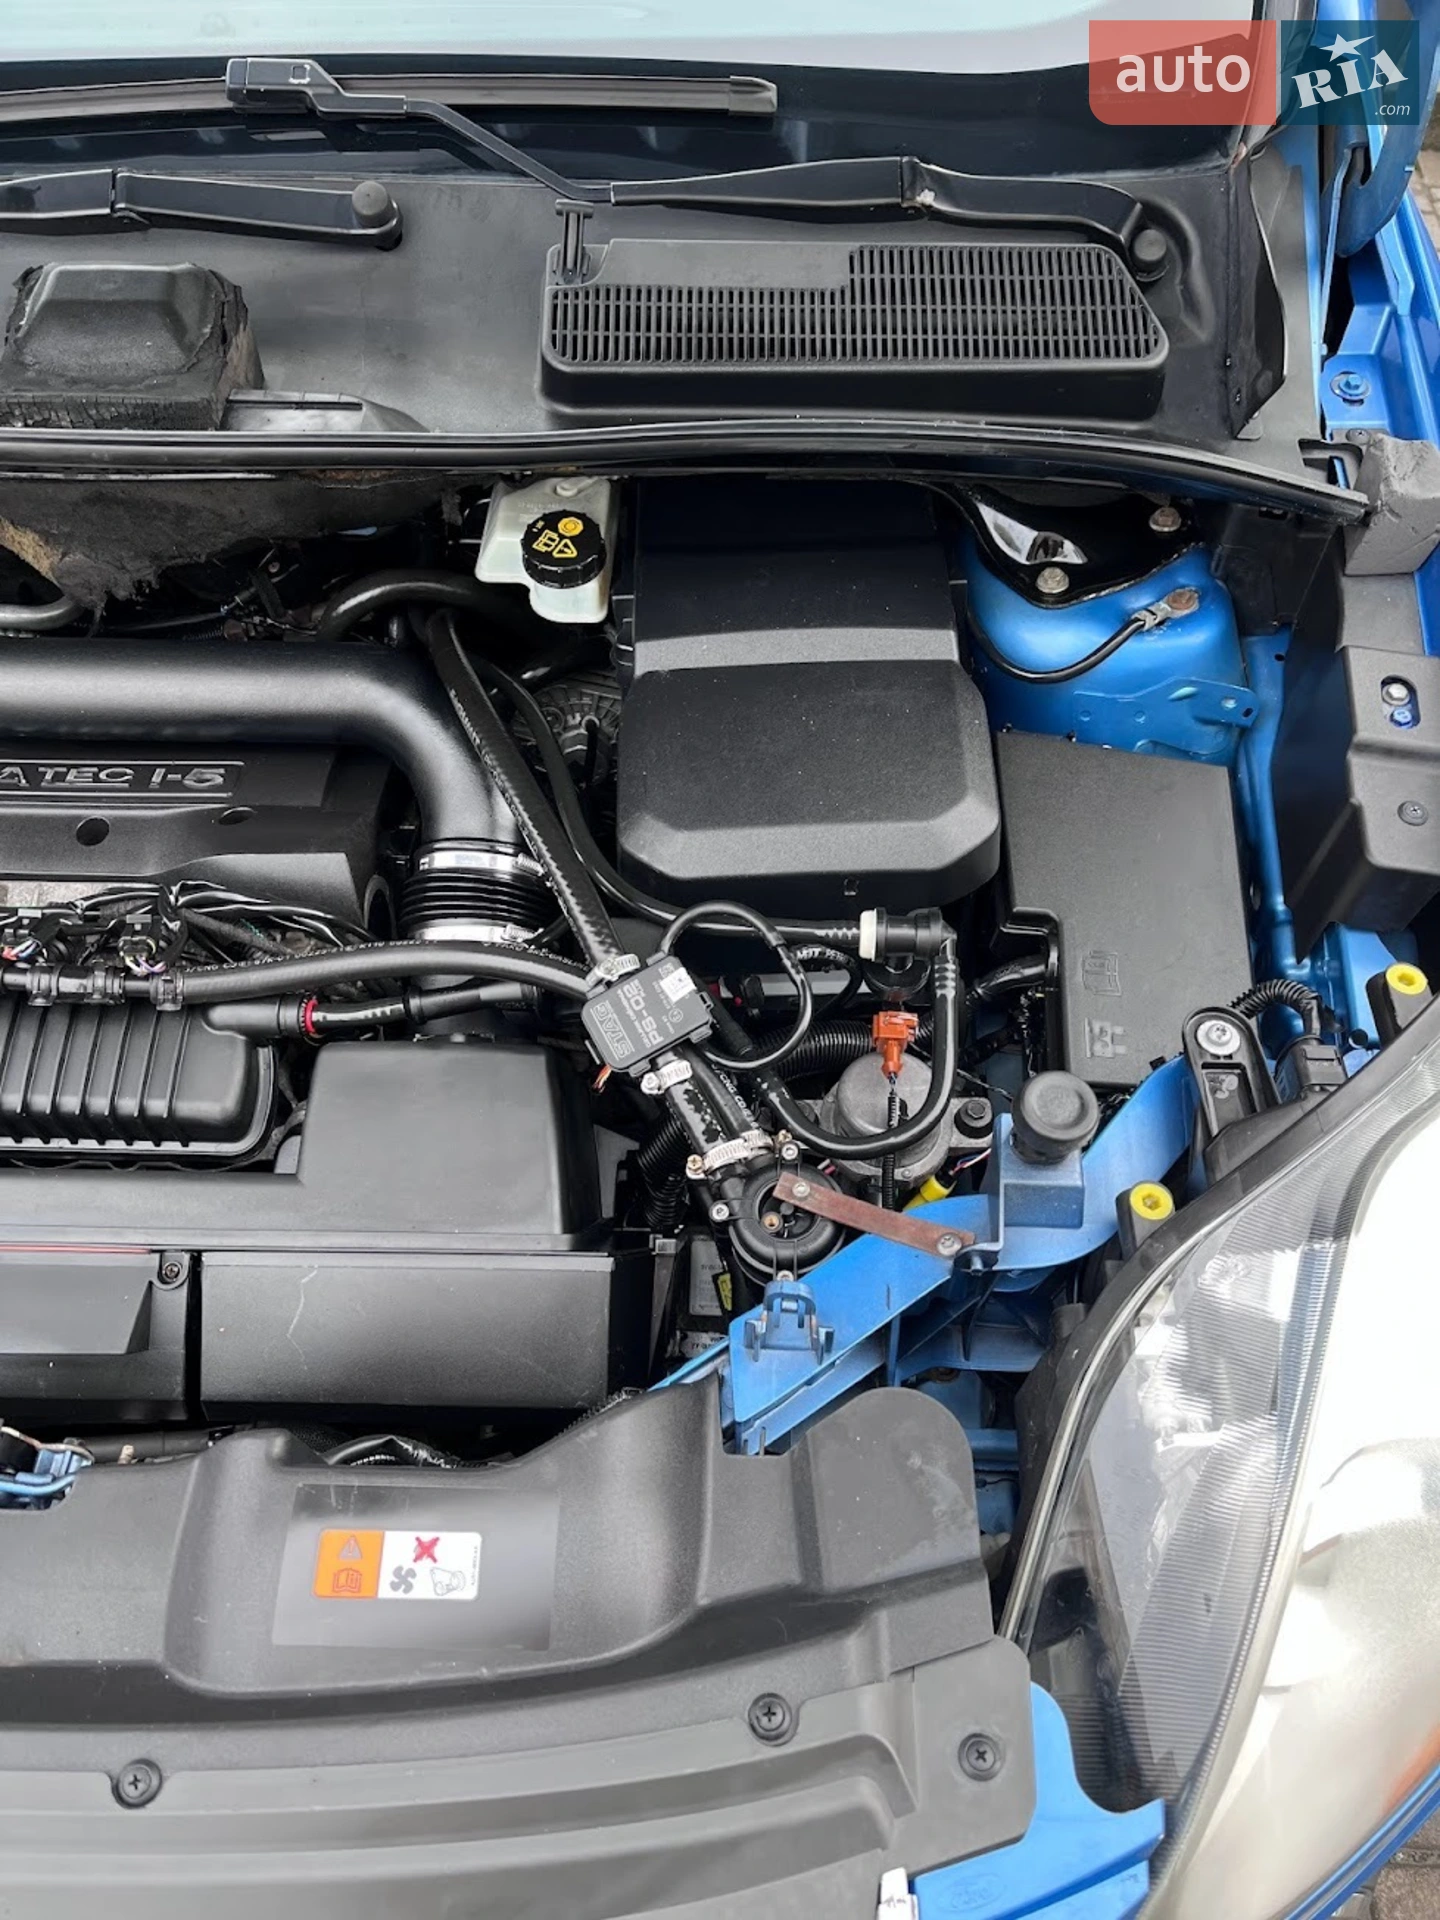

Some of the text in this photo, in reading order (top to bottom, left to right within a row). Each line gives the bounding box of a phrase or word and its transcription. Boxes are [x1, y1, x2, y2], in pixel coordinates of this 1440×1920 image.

[149, 768, 226, 789] I-5
[591, 1001, 632, 1059] STAG
[621, 981, 664, 1044] PS-02
